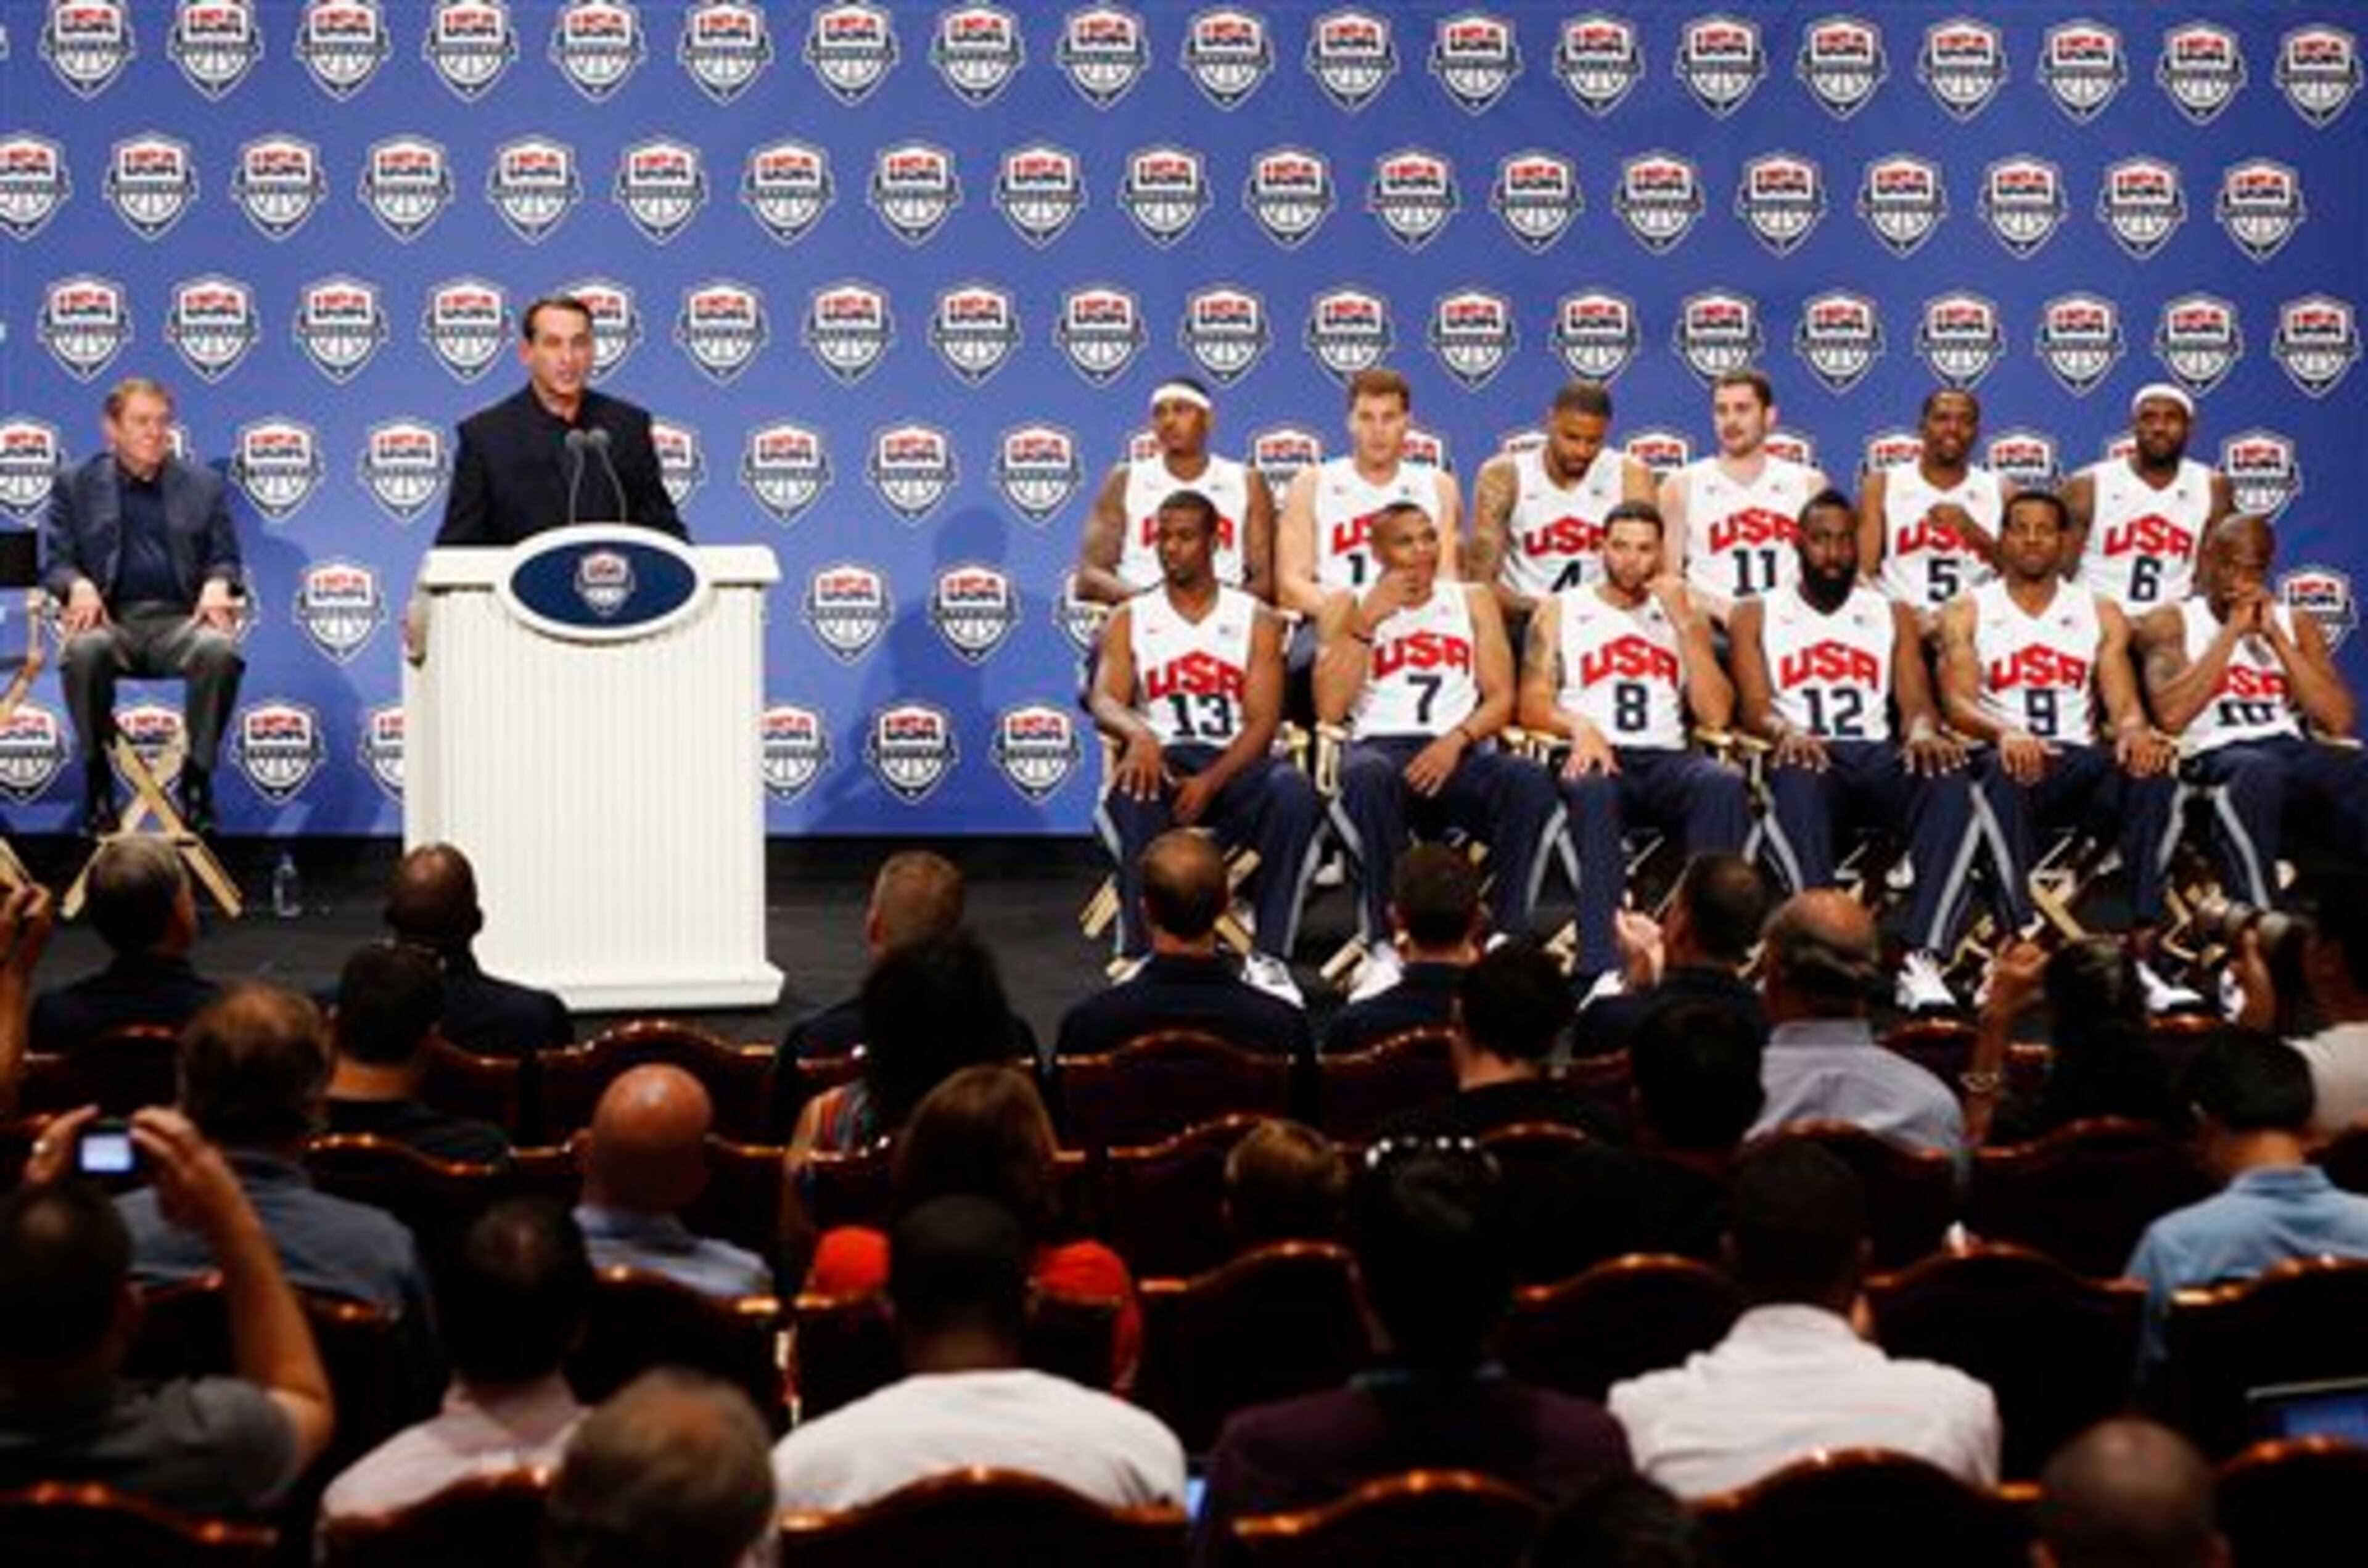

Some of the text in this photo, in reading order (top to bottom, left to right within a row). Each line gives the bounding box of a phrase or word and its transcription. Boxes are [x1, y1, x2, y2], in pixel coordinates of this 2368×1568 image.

[1709, 507, 1802, 555] USA
[2103, 514, 2193, 562] USA
[1732, 549, 1777, 597] 11
[1928, 558, 1958, 602] 5
[2129, 554, 2162, 602] 6
[1146, 651, 1244, 702] USA
[1372, 630, 1470, 680] USA
[1581, 634, 1679, 689] USA
[1779, 639, 1879, 694] USA
[1989, 642, 2086, 694] USA
[1167, 692, 1233, 737] 13
[1407, 674, 1442, 724] 7
[1615, 683, 1647, 731] 8
[1801, 687, 1864, 736] 12
[2025, 689, 2058, 736] 9
